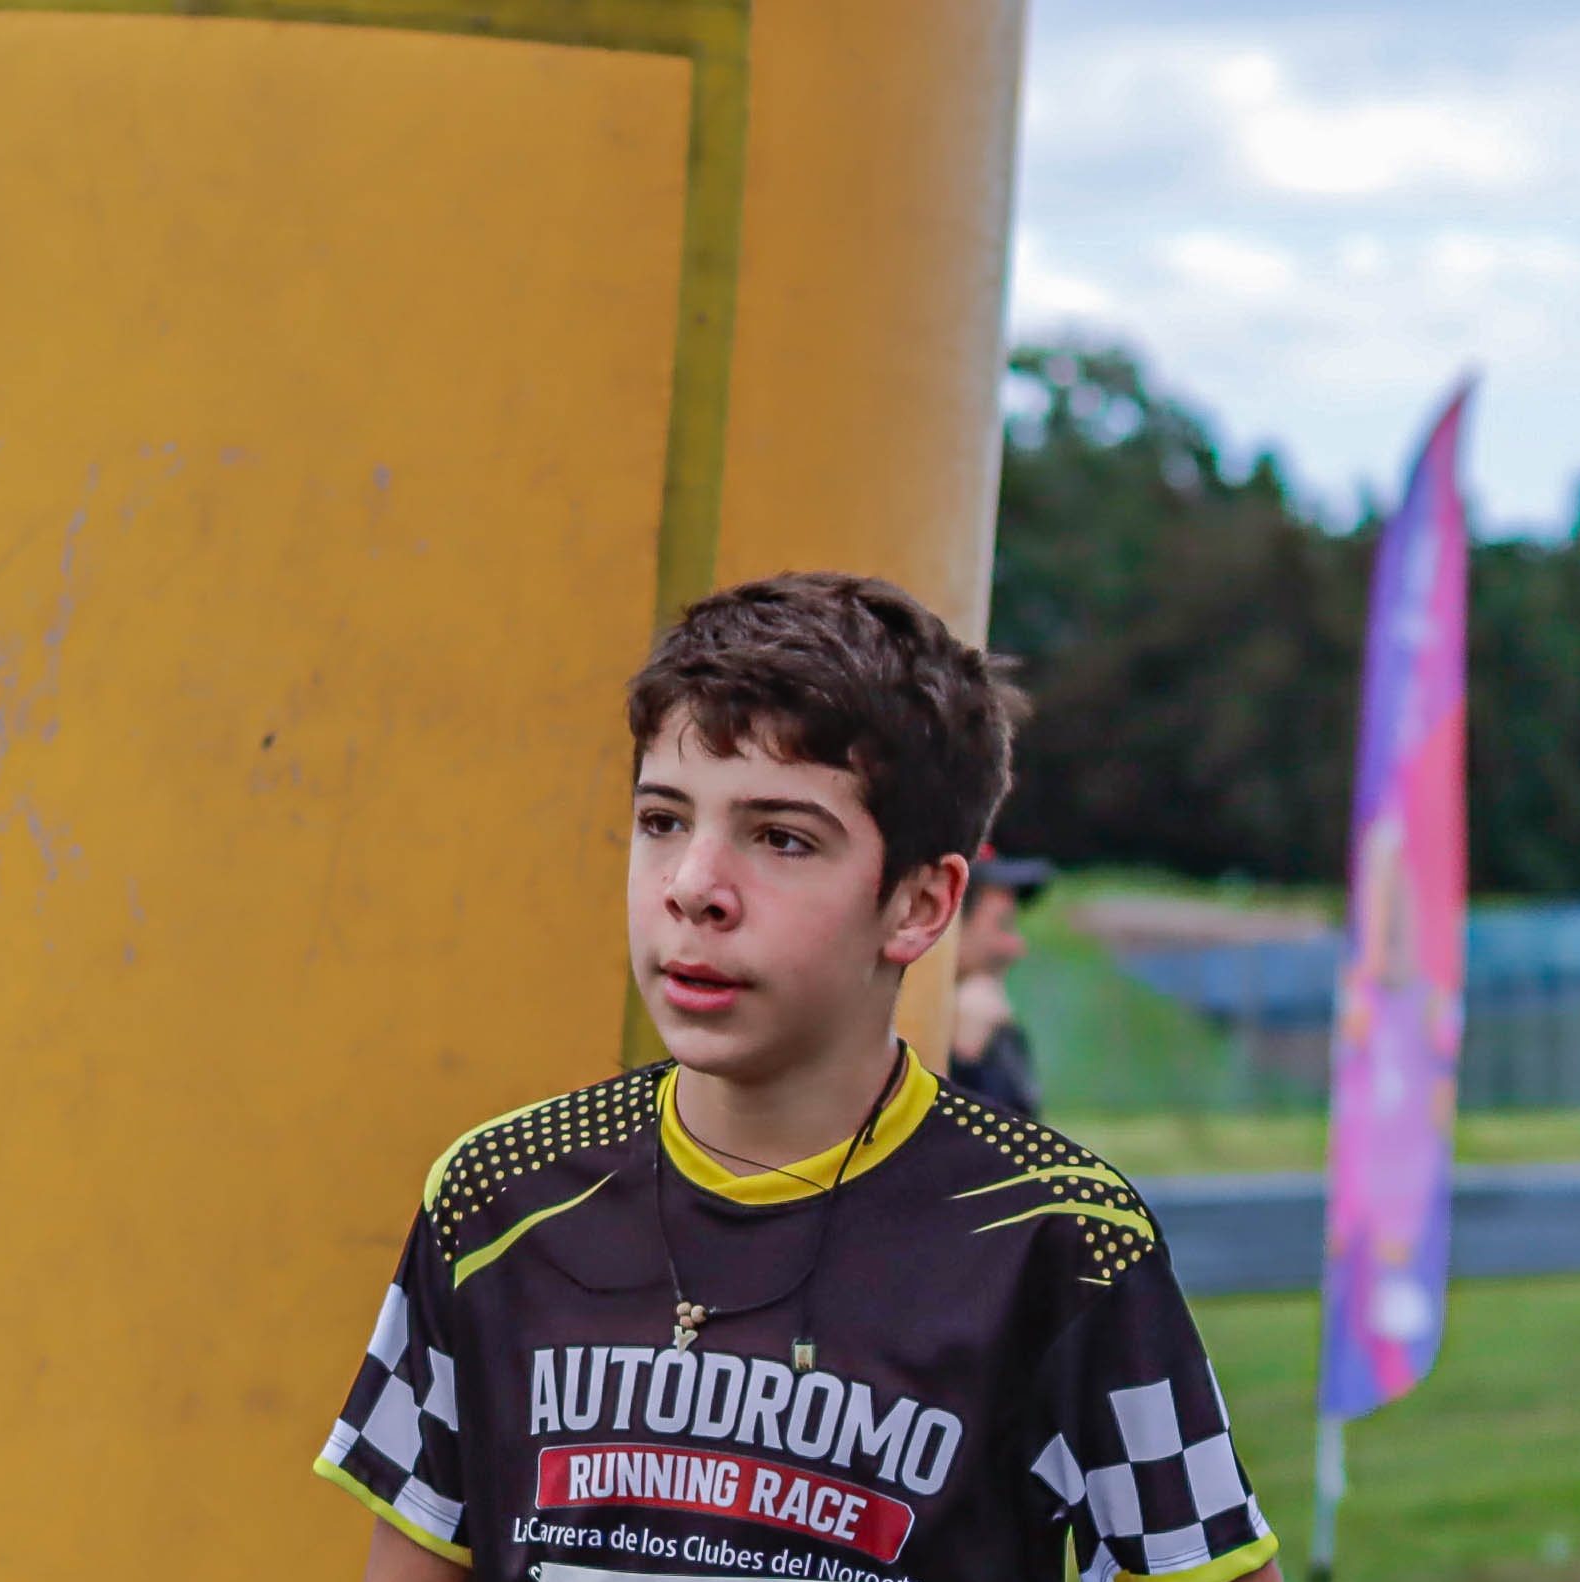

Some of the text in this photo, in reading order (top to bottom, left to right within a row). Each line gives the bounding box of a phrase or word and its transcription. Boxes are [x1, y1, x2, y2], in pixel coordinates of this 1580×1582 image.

[568, 1451, 868, 1541] RUNNING RACE
[528, 1516, 602, 1547] Carrera
[610, 1523, 638, 1551] de
[640, 1528, 678, 1558] los
[683, 1536, 764, 1571] Clubes
[771, 1549, 812, 1577] del
